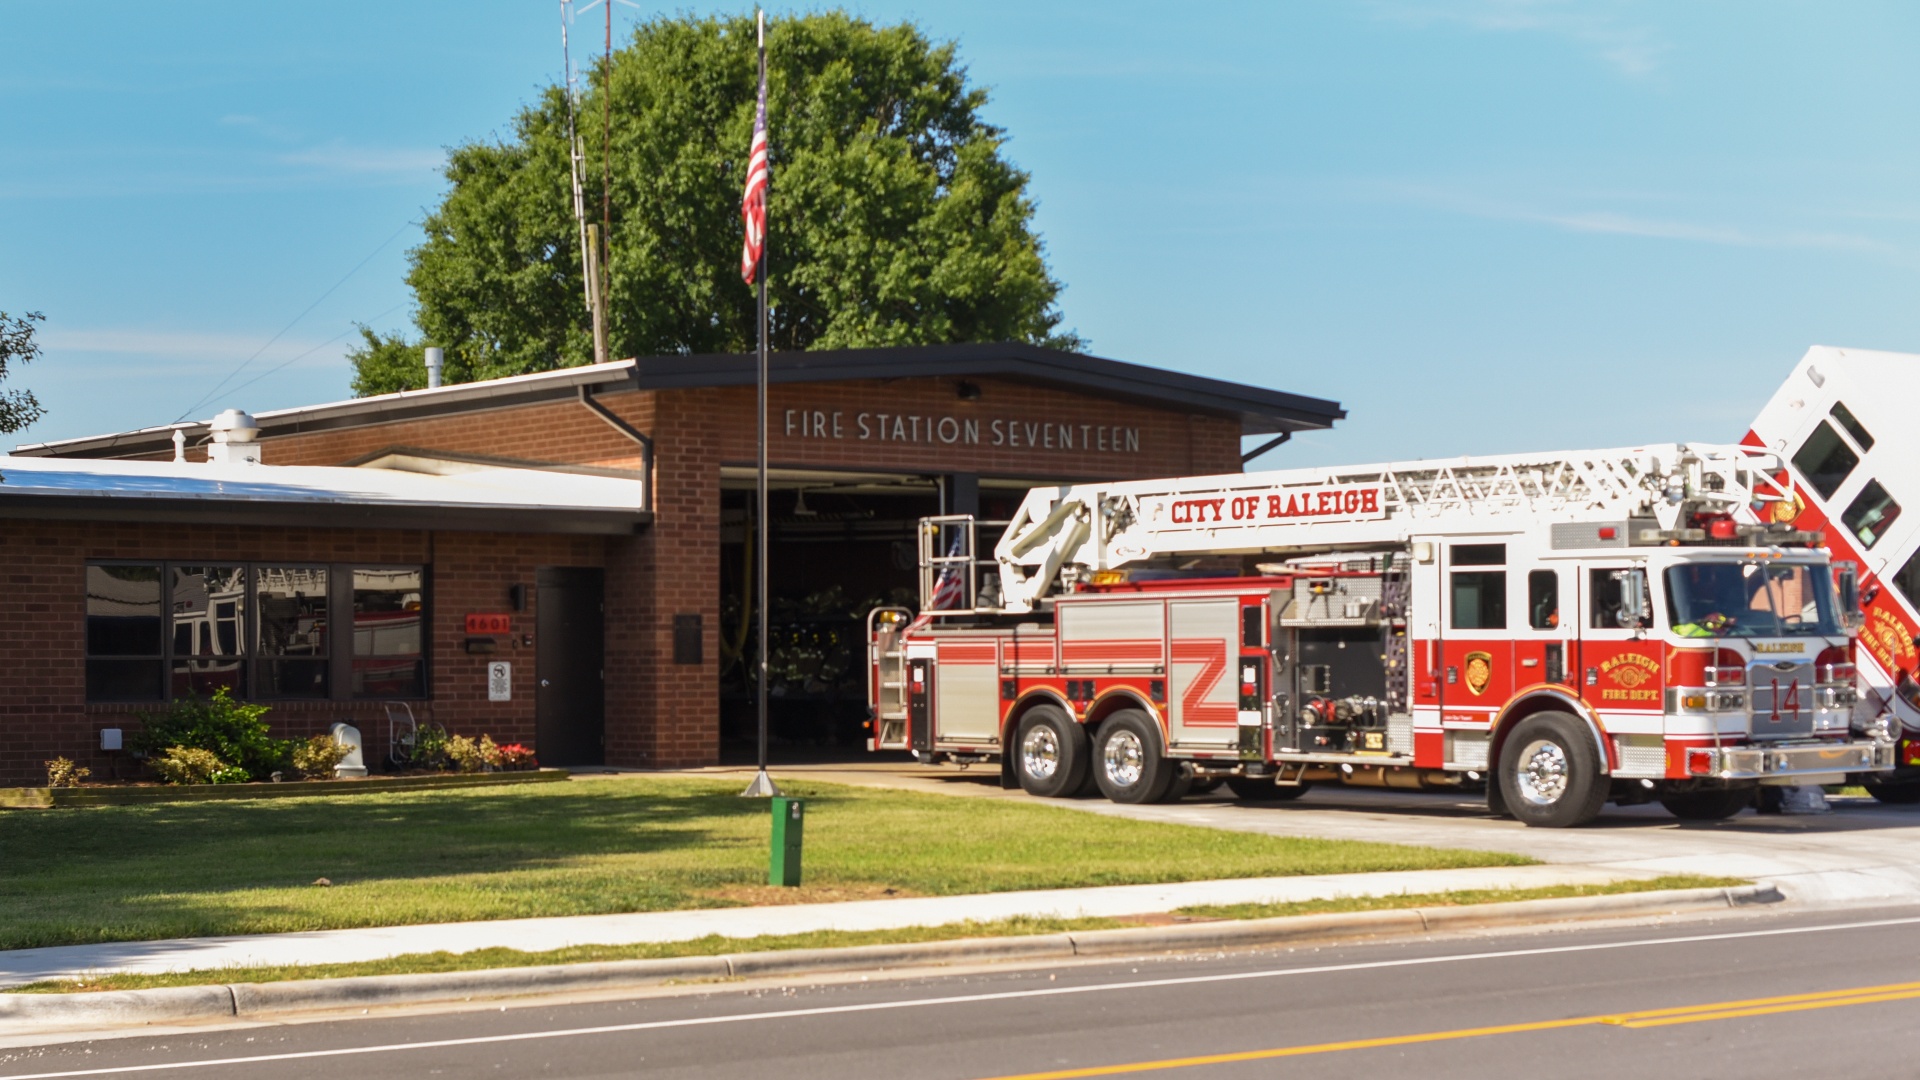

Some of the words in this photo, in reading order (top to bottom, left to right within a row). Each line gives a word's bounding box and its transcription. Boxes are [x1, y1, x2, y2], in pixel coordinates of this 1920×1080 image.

[785, 409, 844, 439] FIRE
[857, 412, 979, 445] STATION
[991, 419, 1141, 452] SEVENTEEN
[1171, 498, 1226, 524] CITY
[1231, 496, 1260, 520] OF
[1267, 488, 1379, 518] RALEIGH
[468, 618, 507, 630] 4601
[1872, 606, 1916, 659] RALEIGH
[1756, 642, 1806, 654] RALEIGH
[1600, 652, 1661, 674] RALEIGH
[1602, 689, 1629, 700] FIRE
[1769, 677, 1800, 723] 14
